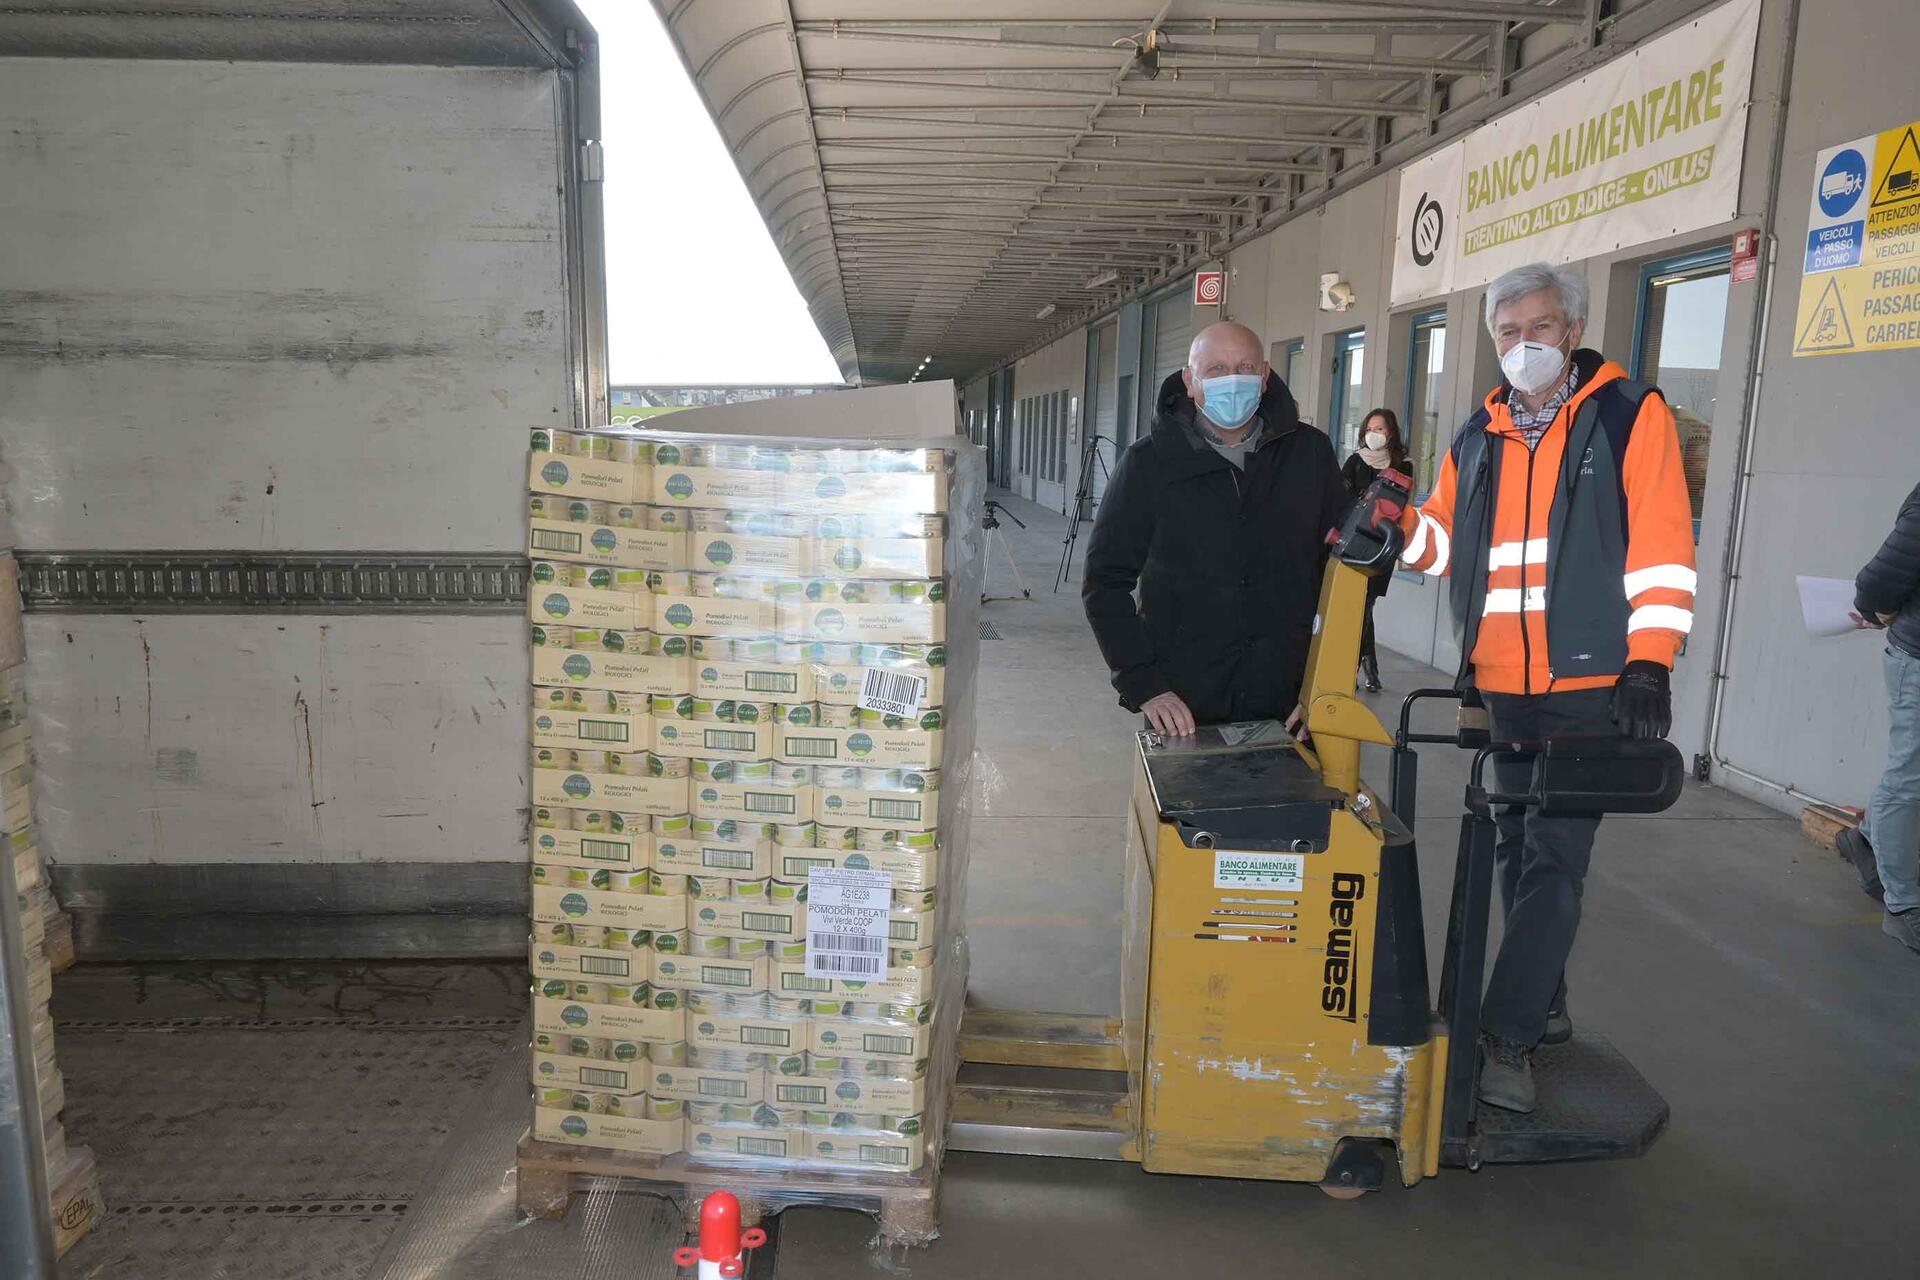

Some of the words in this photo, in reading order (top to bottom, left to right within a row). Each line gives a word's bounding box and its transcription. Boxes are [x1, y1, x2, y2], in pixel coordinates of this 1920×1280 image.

[1468, 144, 1538, 212] BANCO
[1544, 58, 1725, 185] ALIMENTARE
[1465, 214, 1530, 253] TRENTINO
[1532, 198, 1571, 233] ALTO
[1574, 180, 1627, 218] ADIGE
[1643, 148, 1713, 196] ONLUS
[1820, 226, 1853, 241] VEICOLI
[1868, 222, 1920, 241] PASSAGGI
[1815, 245, 1822, 255] A
[1824, 239, 1854, 253] PASSO
[1876, 241, 1915, 258] VEICOLI
[1815, 252, 1850, 267] D'UOMO
[866, 697, 906, 715] 20333801
[1220, 860, 1248, 869] BANCO
[1250, 861, 1297, 871] ALIMENTARE
[809, 905, 855, 916] POMODORI
[858, 908, 888, 918] PELATI
[834, 915, 852, 925] Verde
[853, 917, 873, 927] COOP
[850, 926, 866, 936] 400g
[1321, 872, 1365, 1013] samag
